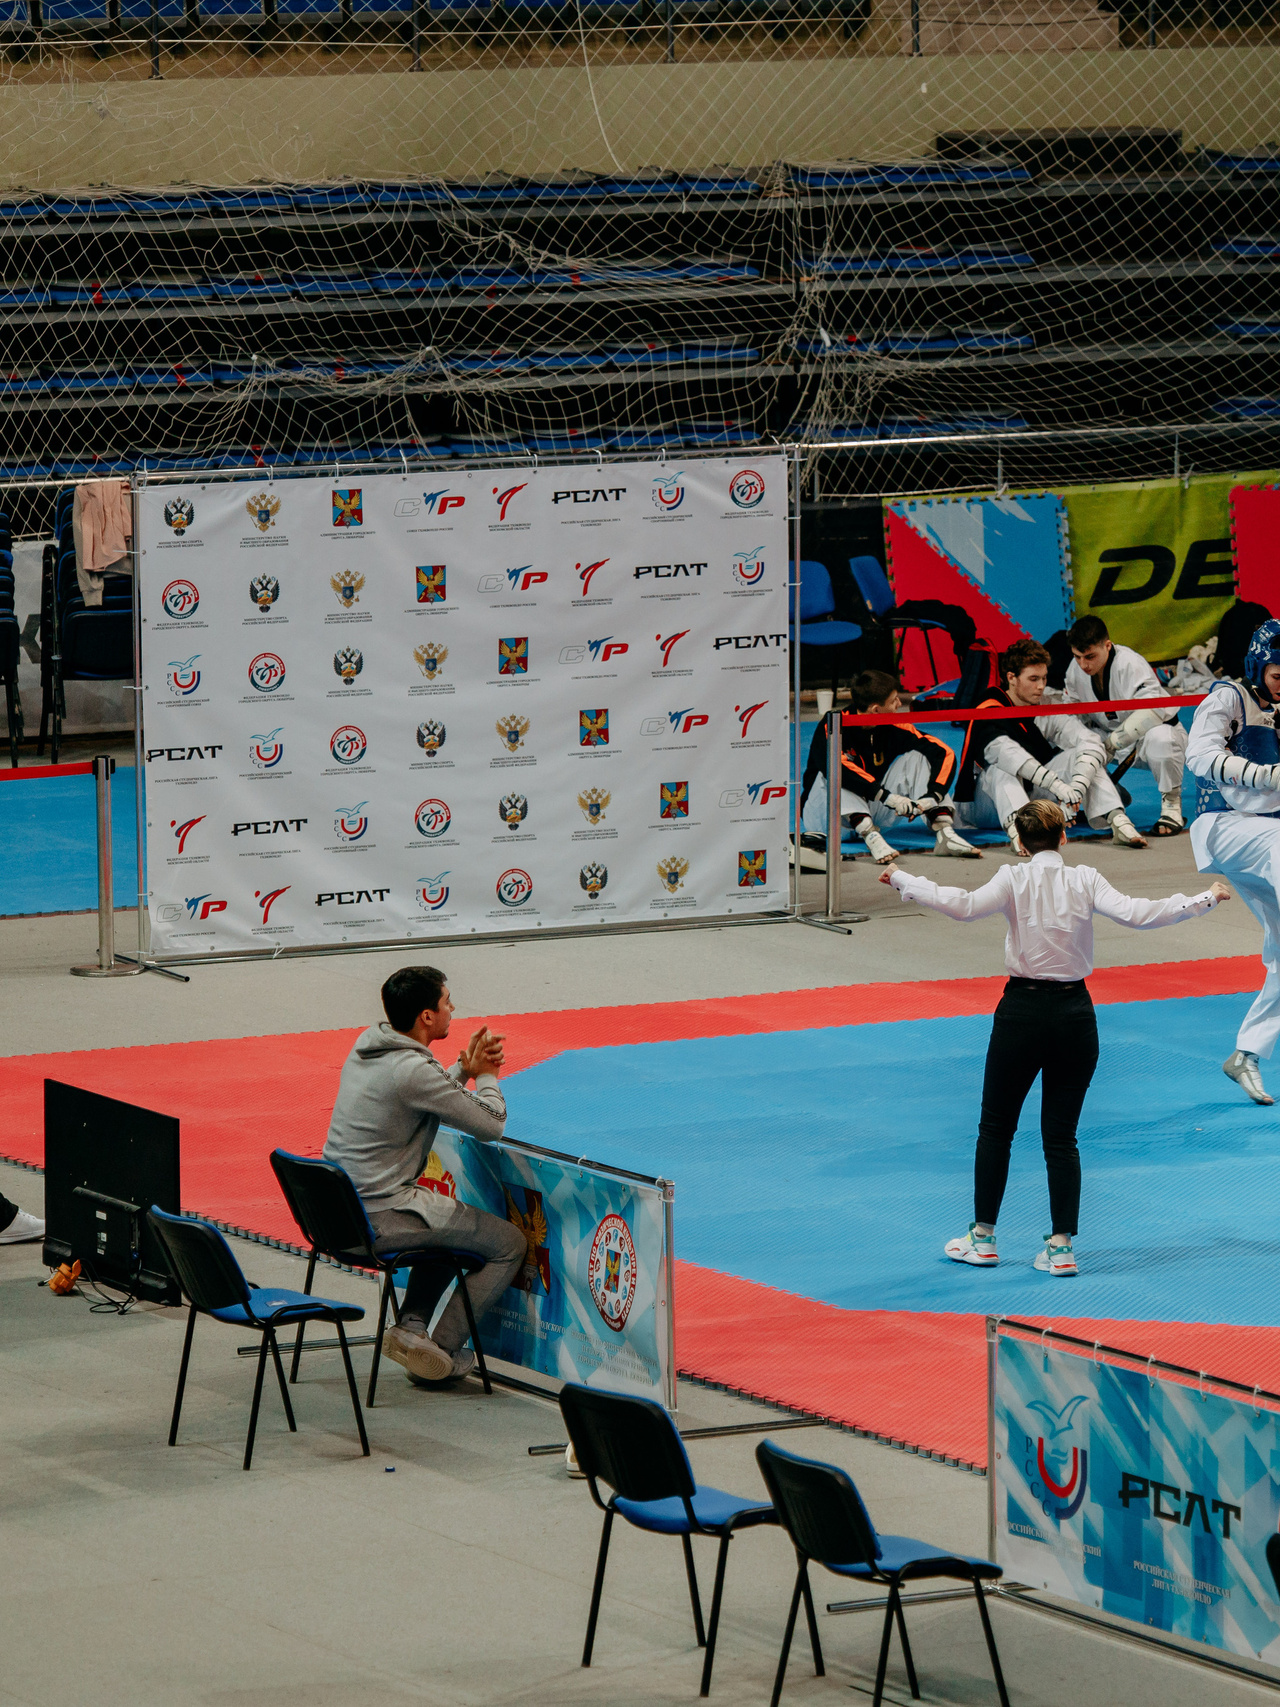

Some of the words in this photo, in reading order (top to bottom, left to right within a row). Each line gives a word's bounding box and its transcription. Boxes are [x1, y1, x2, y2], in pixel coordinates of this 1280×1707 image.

[552, 487, 626, 504] РСЛТ
[633, 562, 707, 579] РСЛТ
[713, 633, 786, 649] РСЛТ
[146, 744, 222, 762] РСЛТ
[231, 818, 307, 836] РСЛТ
[315, 888, 390, 906] РСЛТ
[1118, 1471, 1241, 1540] РСЛТ
